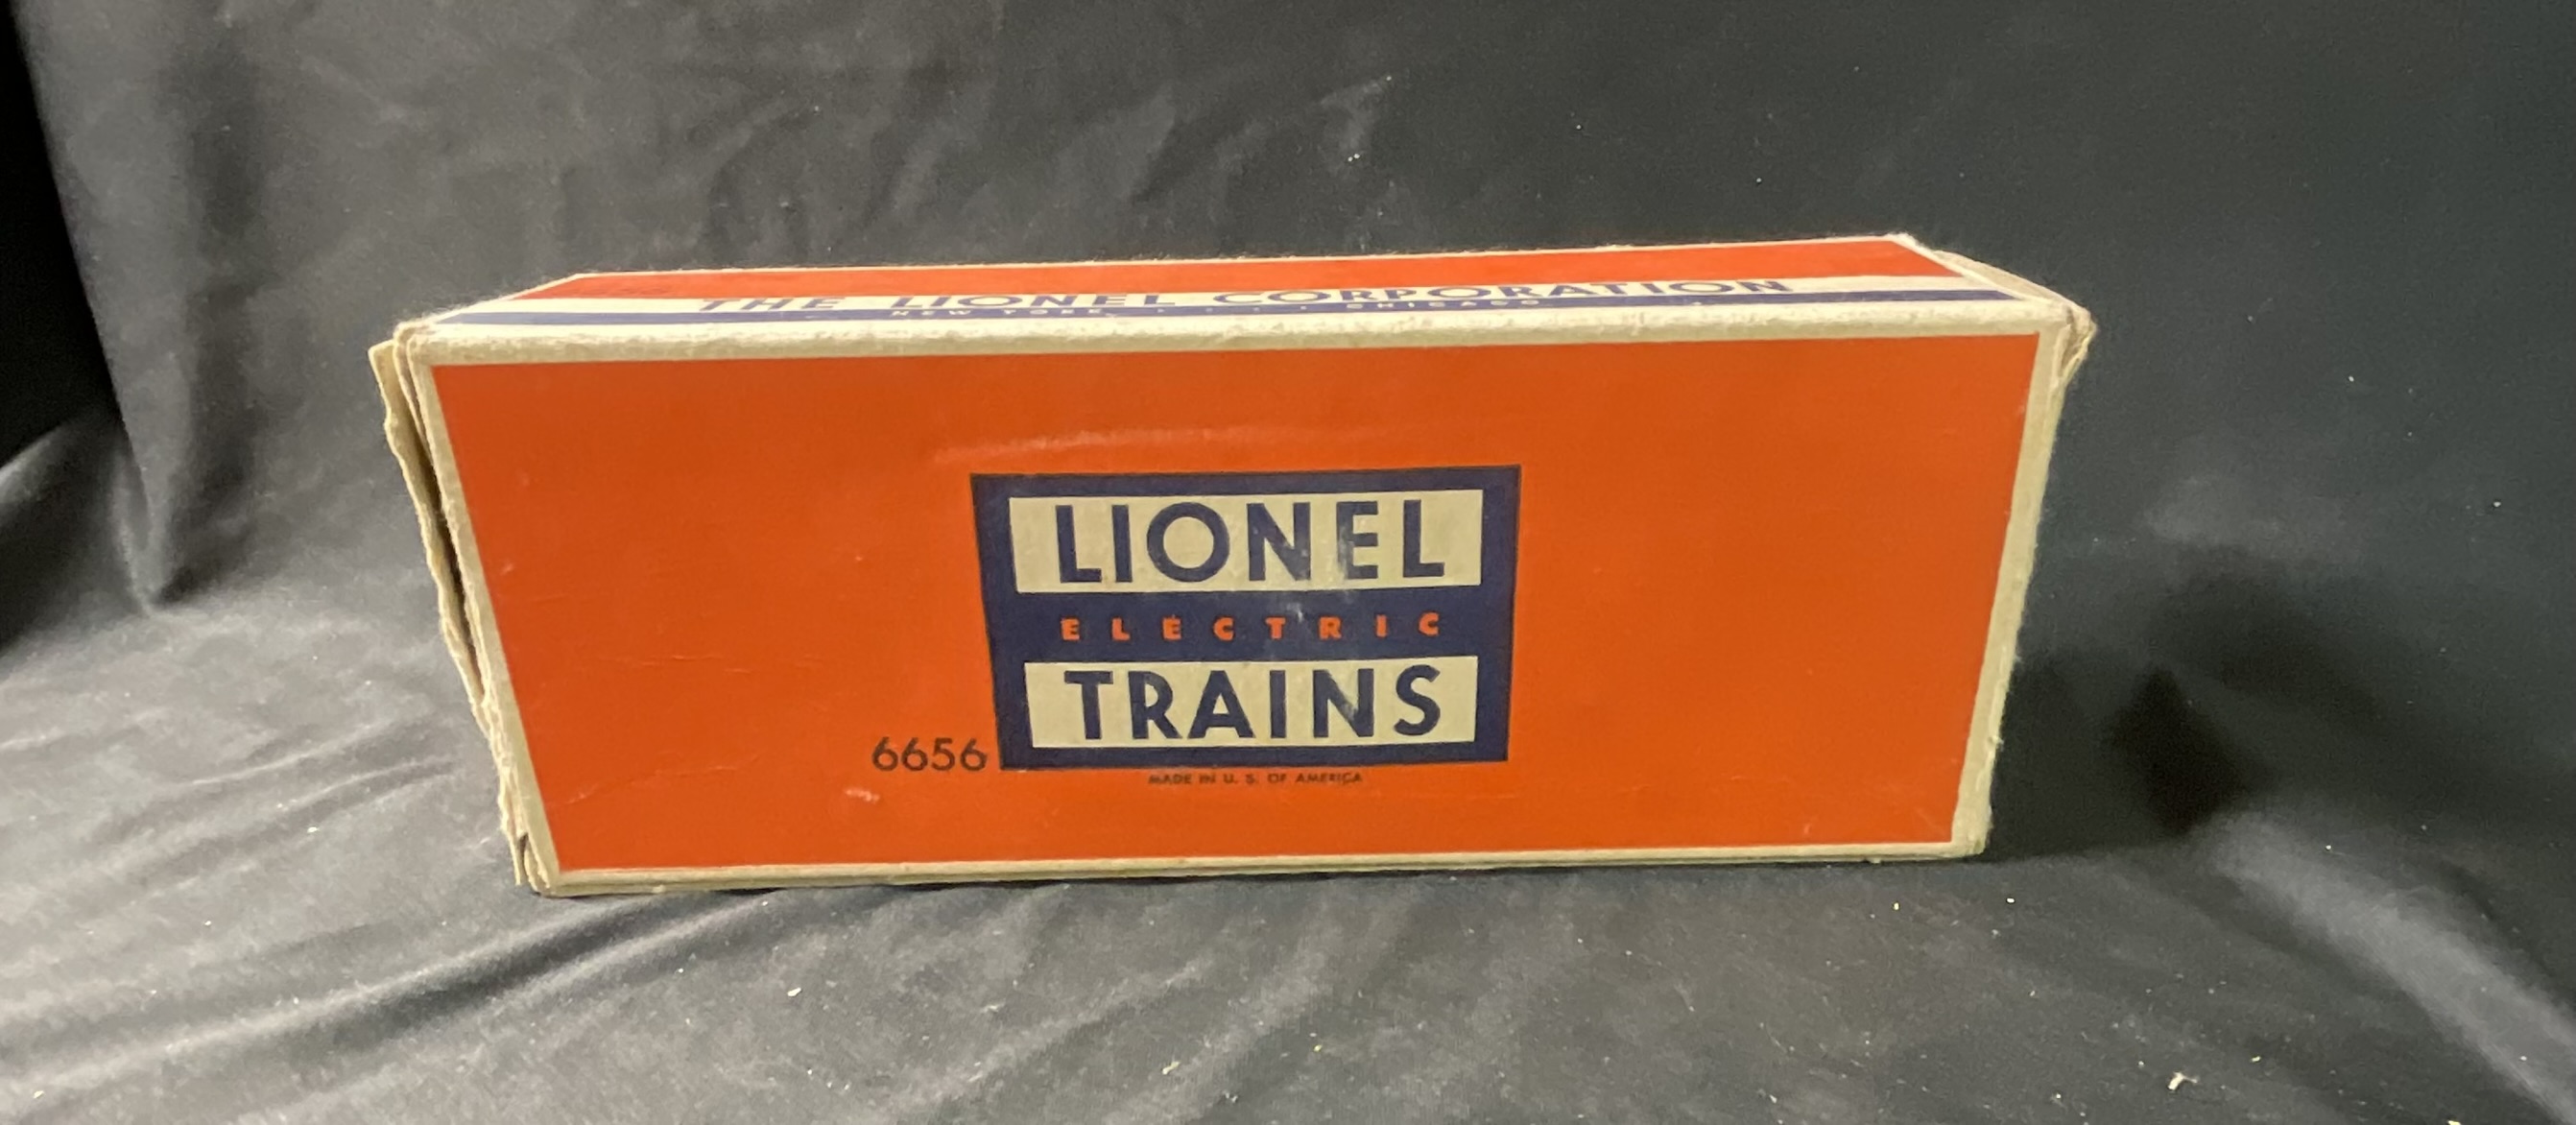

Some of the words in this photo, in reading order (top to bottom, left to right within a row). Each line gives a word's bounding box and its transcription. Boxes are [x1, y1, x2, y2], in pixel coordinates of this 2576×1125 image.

[700, 297, 845, 311] THE
[891, 294, 1176, 308] LIONEL
[1213, 280, 1792, 303] CORPORATION
[890, 309, 971, 318] NEW
[1055, 498, 1445, 584] LIONEL
[1060, 611, 1441, 641] ELECTRIC
[1063, 663, 1442, 741] TRAINS
[871, 736, 988, 772] 6656
[1148, 773, 1191, 785] MADE
[1200, 773, 1216, 784] IN
[1267, 773, 1287, 783] OF
[1296, 771, 1363, 784] AMERICA
